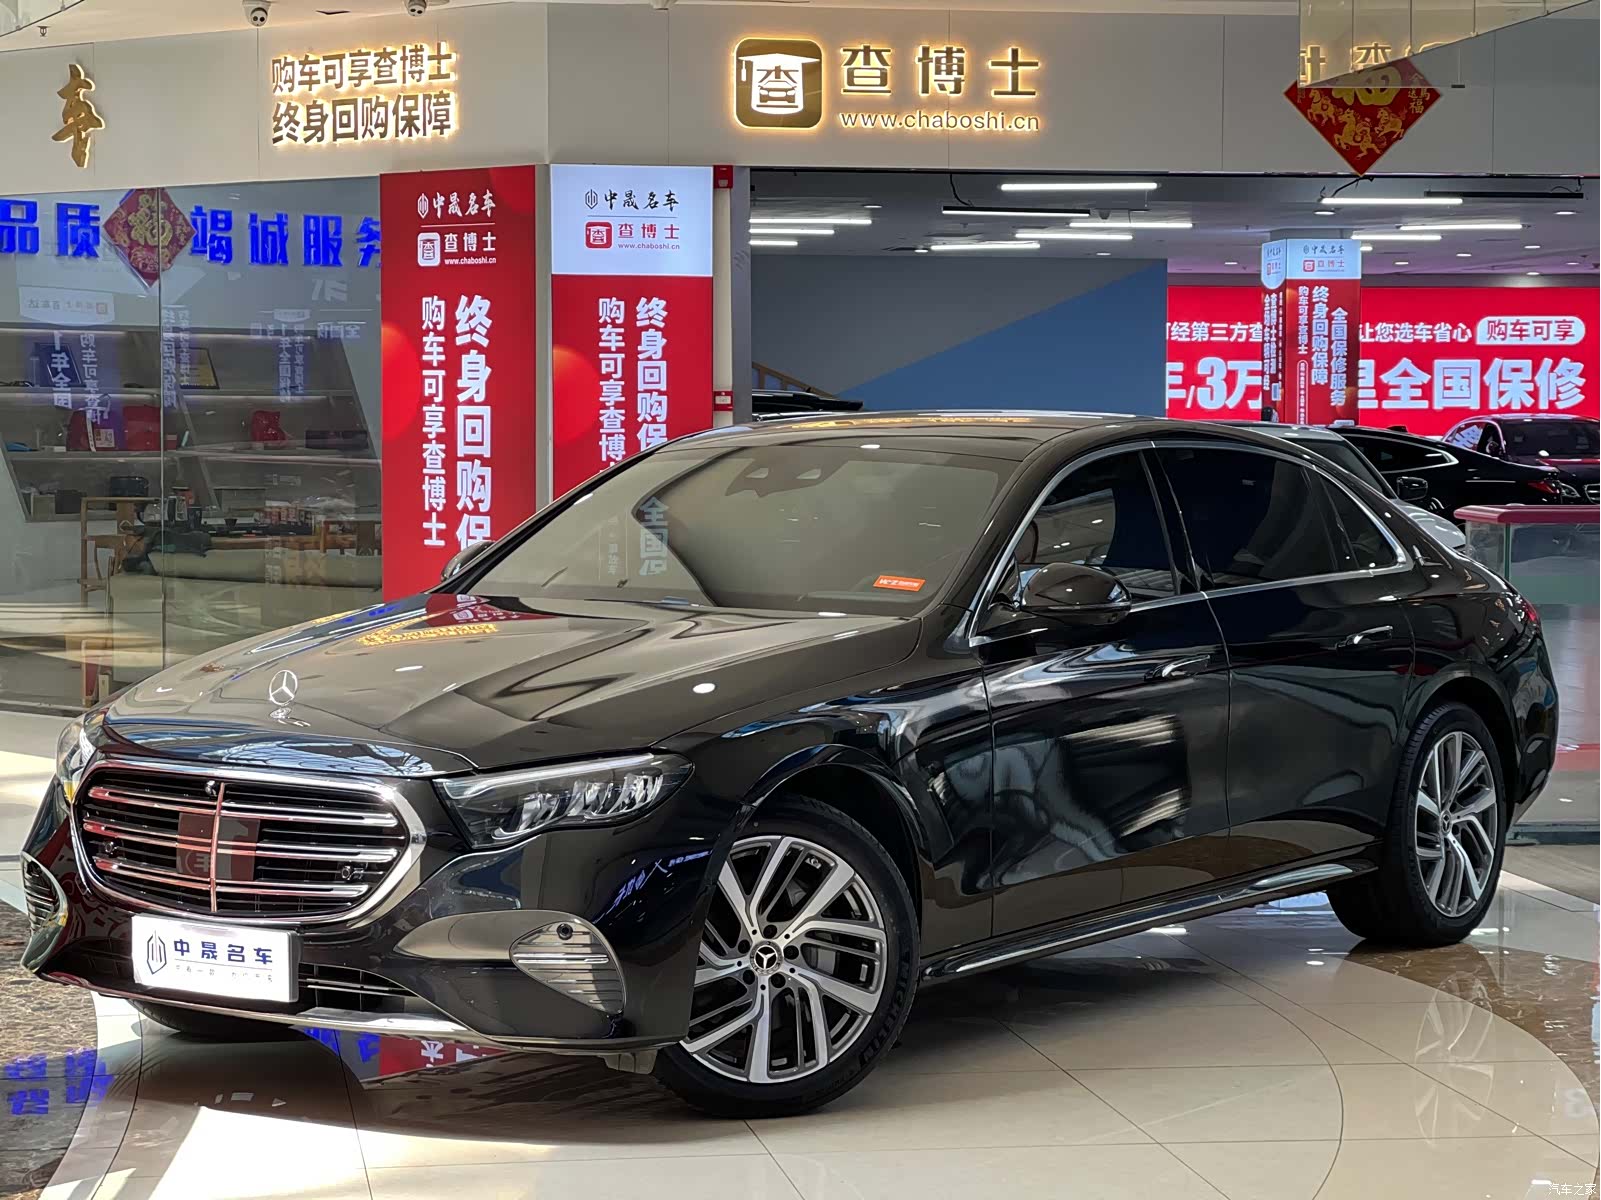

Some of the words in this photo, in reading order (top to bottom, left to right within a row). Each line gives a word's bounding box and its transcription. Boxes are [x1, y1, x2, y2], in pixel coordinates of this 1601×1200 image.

[271, 42, 455, 93] 购车可享查博士
[841, 44, 1040, 96] 查博士
[271, 91, 453, 145] 终身回购保障
[841, 111, 1039, 131] www.chaboshi.cn
[604, 188, 680, 212] 中晟名车
[0, 199, 101, 258] 品质
[444, 232, 497, 253] 查博士
[617, 223, 680, 240] 查博士
[444, 255, 497, 265] www.chaboshi.cn
[1311, 286, 1329, 385] 终身回购保障
[1359, 321, 1472, 343] 让您选车省心
[1486, 319, 1577, 341] 购车可享
[1330, 307, 1348, 406] 全国保修服务
[599, 297, 626, 473] 购车可享查博
[422, 295, 446, 547] 购车可享查博士
[173, 938, 273, 965] 中晟名车
